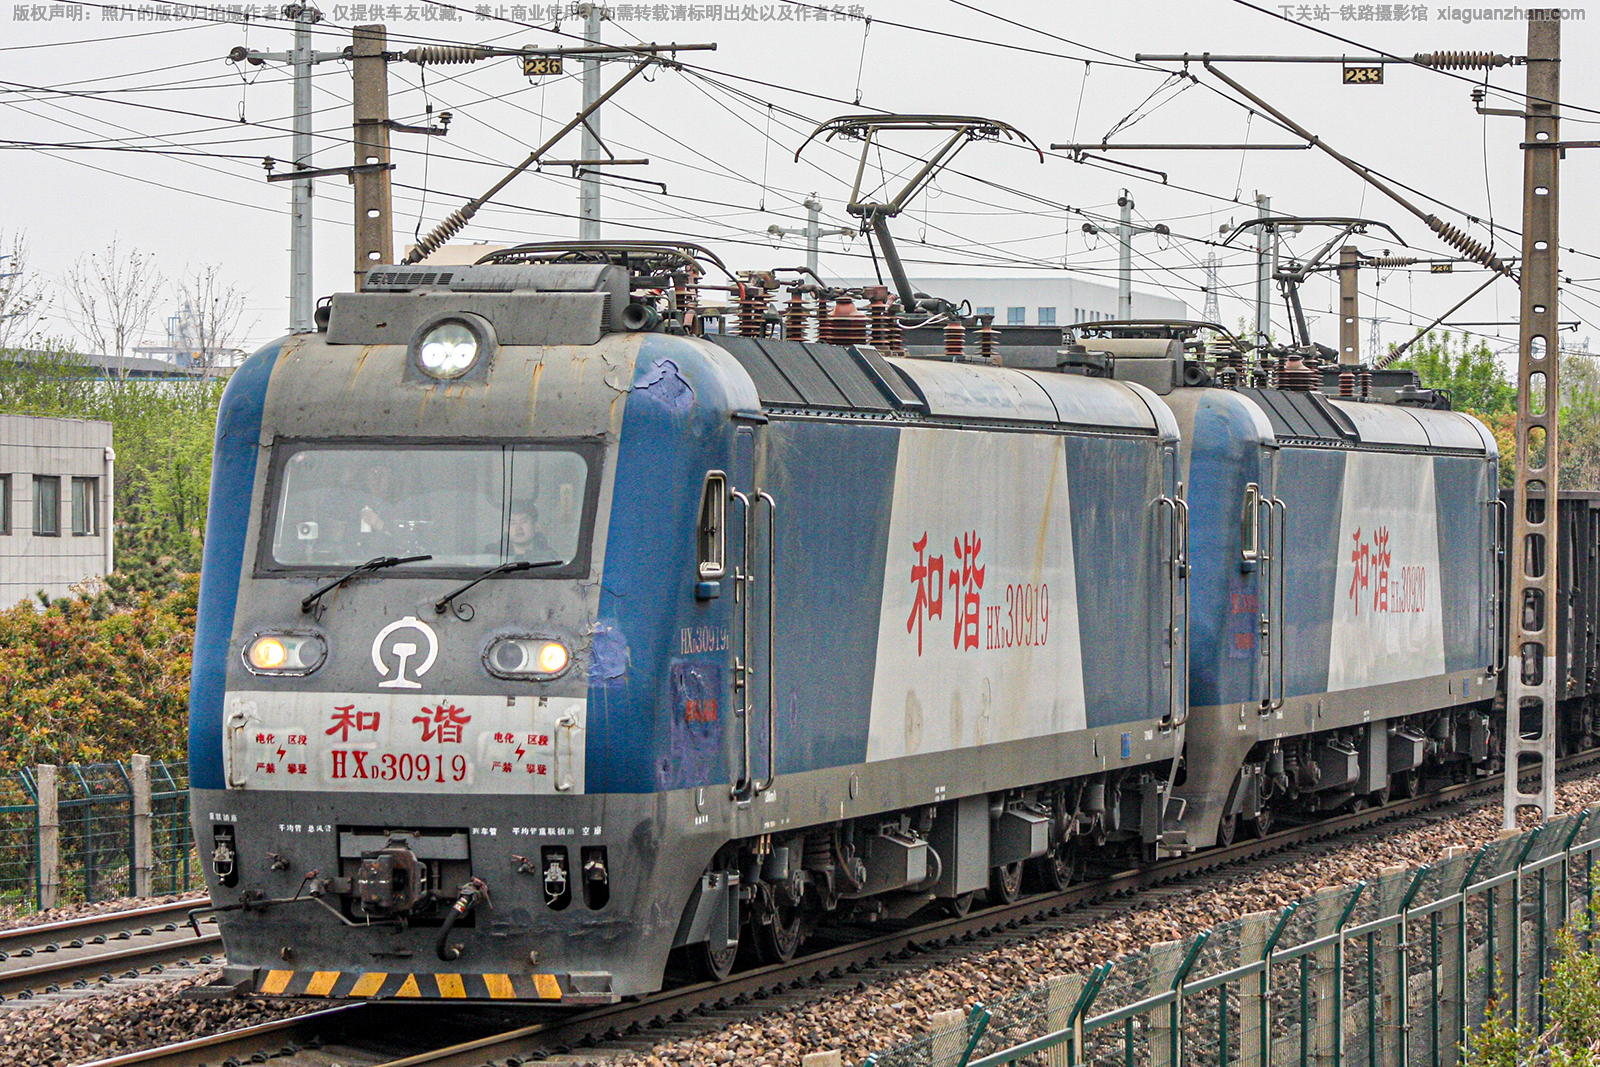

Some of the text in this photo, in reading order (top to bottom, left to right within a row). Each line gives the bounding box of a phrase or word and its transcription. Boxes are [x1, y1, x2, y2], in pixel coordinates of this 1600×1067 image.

[526, 60, 561, 74] 236
[1346, 68, 1382, 83] 233
[1349, 525, 1391, 616] 和谐
[907, 529, 1049, 657] 和谐 HXD30919
[255, 733, 308, 746] 电化 区段
[494, 731, 549, 746] 电化 区段
[255, 762, 308, 775] 严禁 攀登
[331, 750, 467, 784] HXD30919
[491, 761, 548, 776] 严禁 攀登
[472, 827, 498, 836] 列车管
